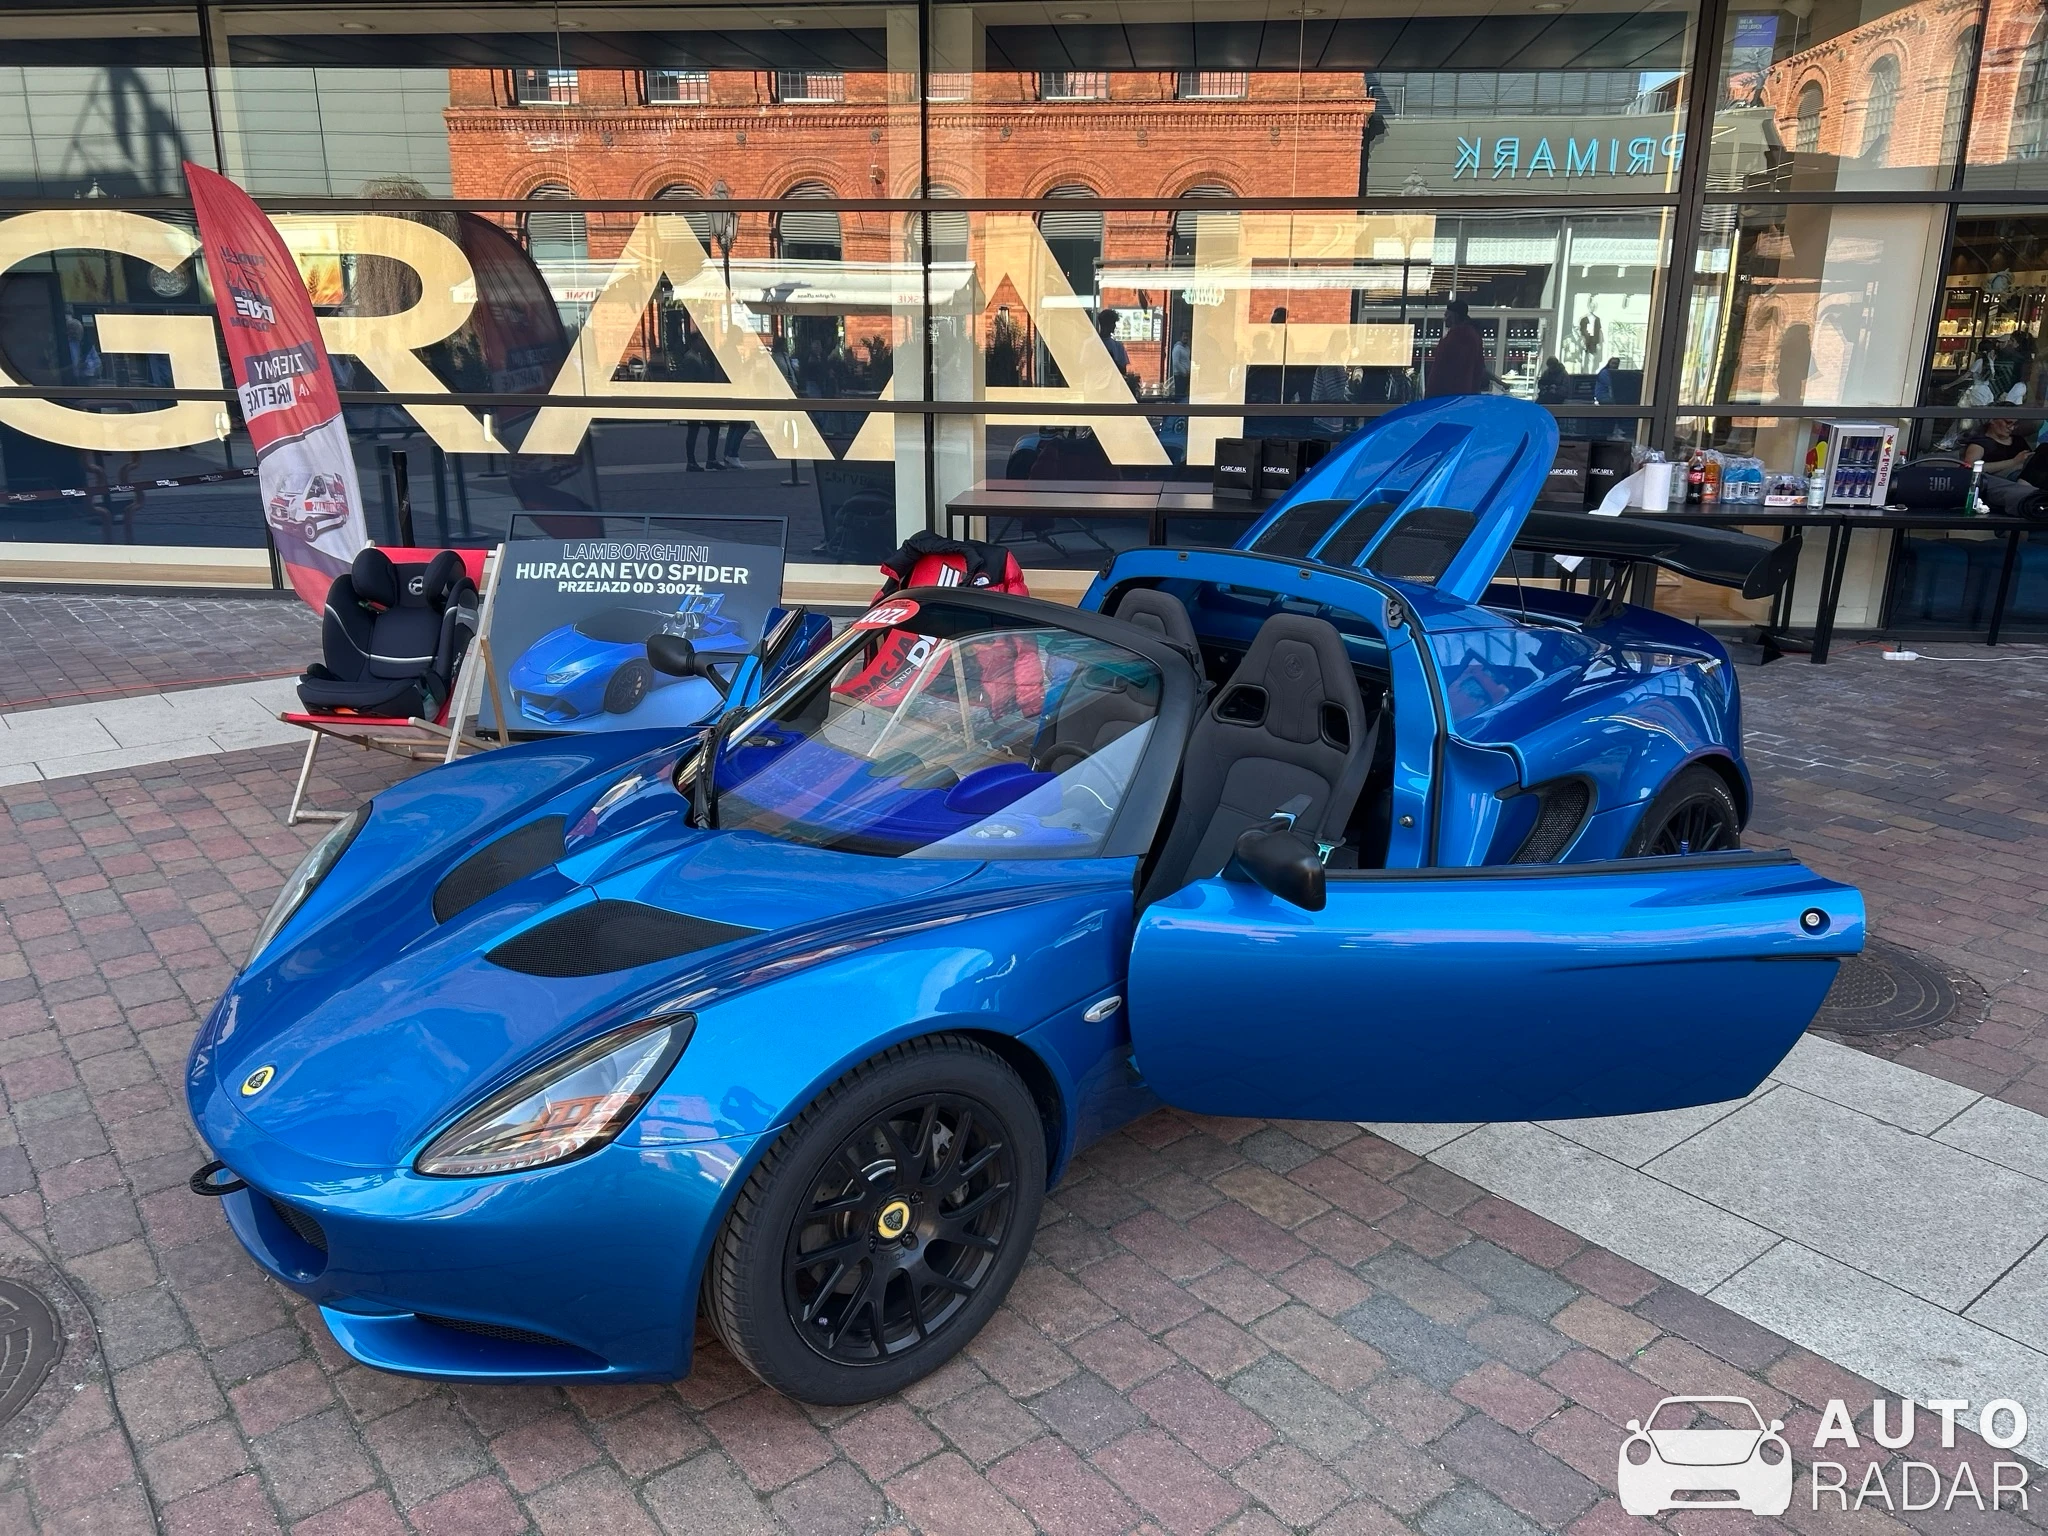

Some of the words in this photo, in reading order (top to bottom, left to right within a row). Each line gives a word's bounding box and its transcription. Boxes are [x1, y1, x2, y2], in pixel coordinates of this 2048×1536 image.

[1220, 464, 1247, 474] GARCAREK
[1263, 466, 1290, 475] GARCAREK
[1549, 467, 1579, 477] ARCAREK
[1589, 467, 1615, 477] ARCAREK
[1929, 476, 1954, 492] JBL
[562, 543, 709, 563] LAMBORGHINI
[515, 562, 615, 580] HURACAN
[620, 563, 663, 581] EVO
[667, 564, 749, 585] SPIDER
[558, 581, 630, 593] PRZEJAZD
[633, 582, 654, 594] OD
[656, 582, 704, 596] 300ZŁ
[894, 667, 912, 687] AND
[884, 1215, 902, 1229] LOTUS
